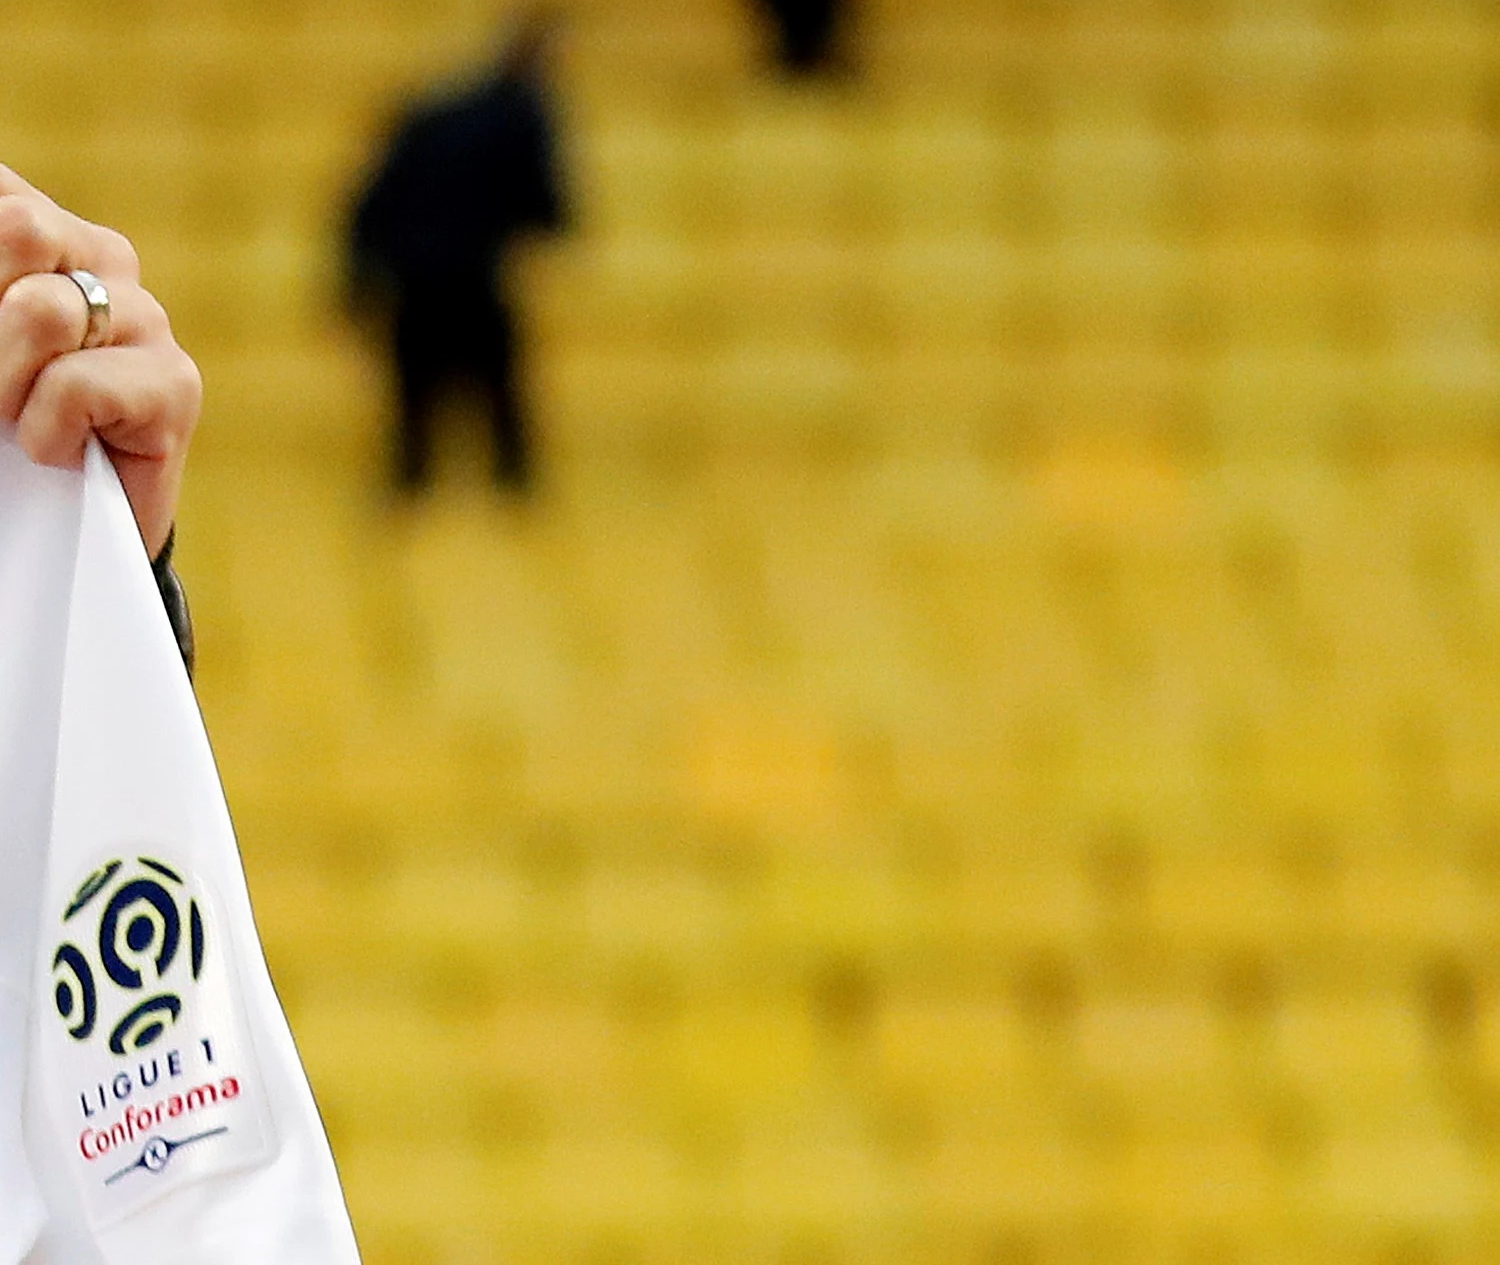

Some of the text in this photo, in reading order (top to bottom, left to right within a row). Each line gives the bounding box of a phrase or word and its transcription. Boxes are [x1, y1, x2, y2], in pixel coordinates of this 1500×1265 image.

[79, 1076, 241, 1161] Conforama
[80, 1037, 213, 1118] LIGUE 1
